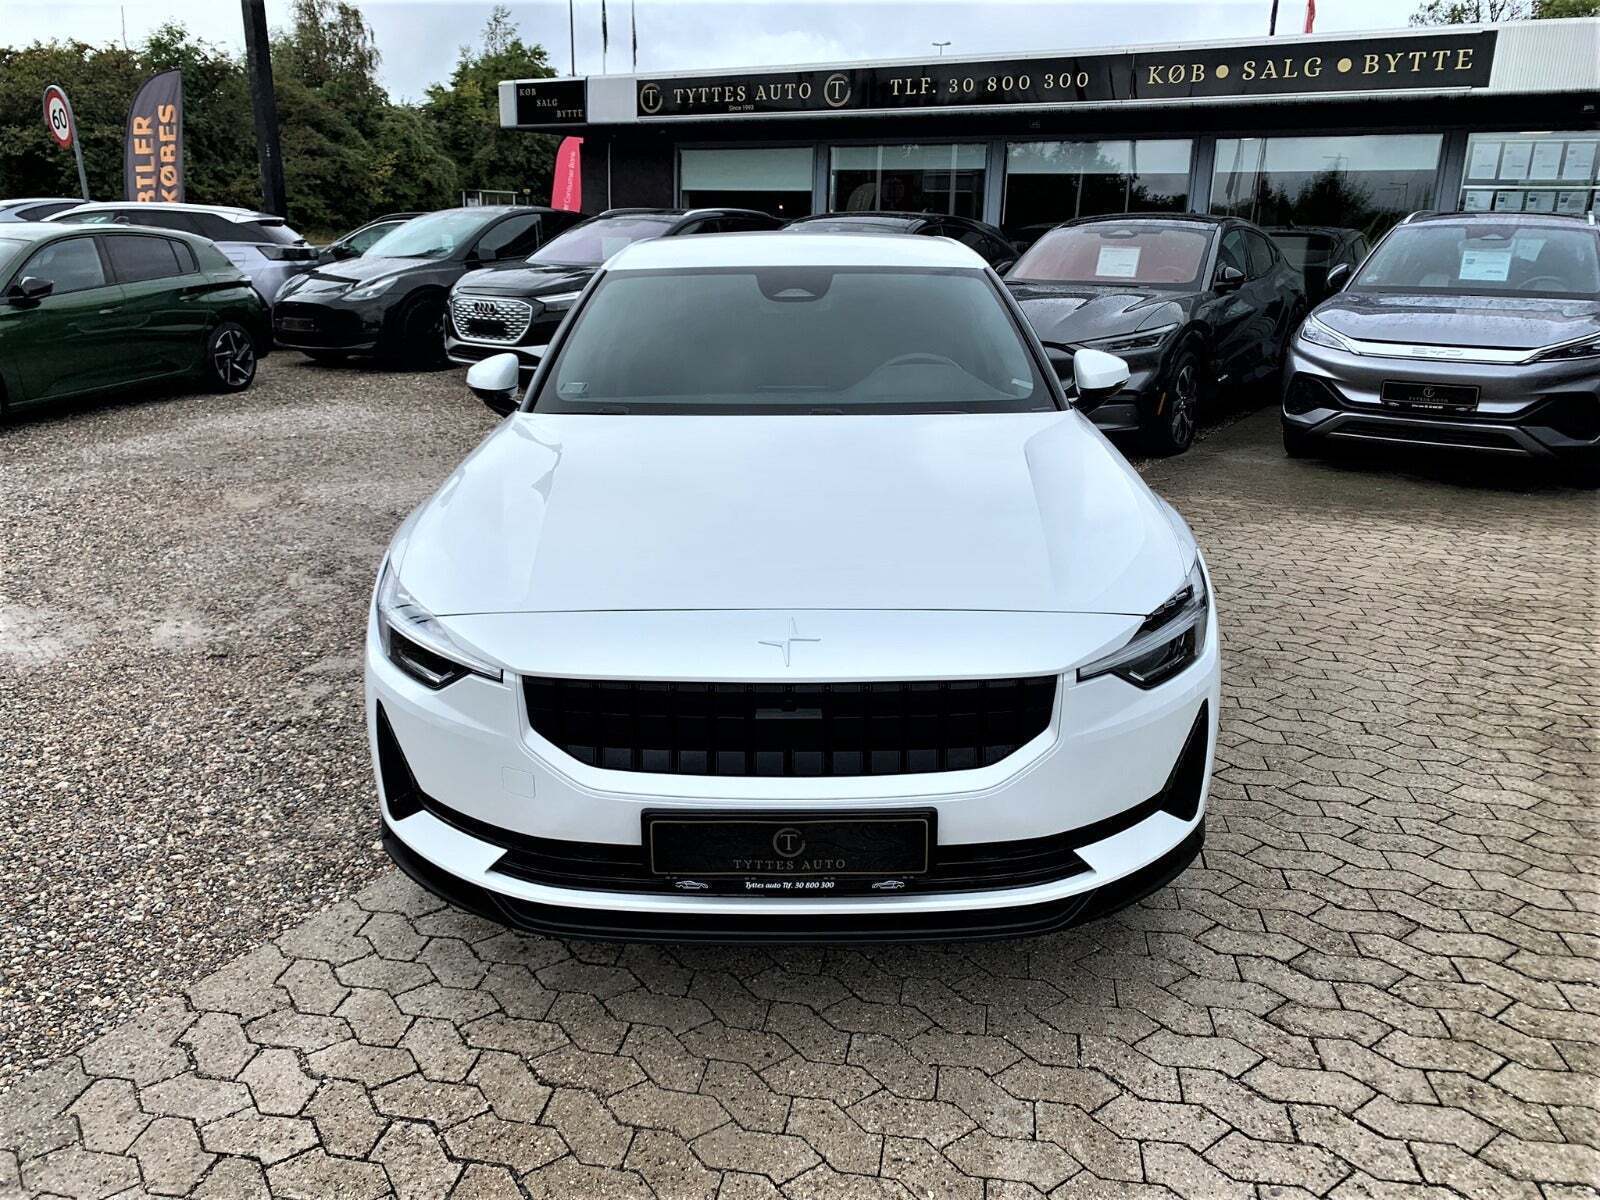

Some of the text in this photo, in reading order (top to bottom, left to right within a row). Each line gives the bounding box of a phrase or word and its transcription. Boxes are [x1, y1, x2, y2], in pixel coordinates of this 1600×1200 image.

[1147, 48, 1474, 85] KØB SALG BYTTE
[673, 82, 812, 104] TYTTES AUTO
[890, 71, 1089, 96] TLF. 30 800 300
[536, 98, 559, 107] SALG
[728, 104, 742, 112] Since
[52, 109, 67, 130] 60
[556, 109, 583, 118] BYTTE
[134, 116, 156, 202] BILER
[157, 104, 179, 203] KØBES
[733, 859, 846, 870] TYTTES AUTO
[745, 881, 764, 890] Tyttes
